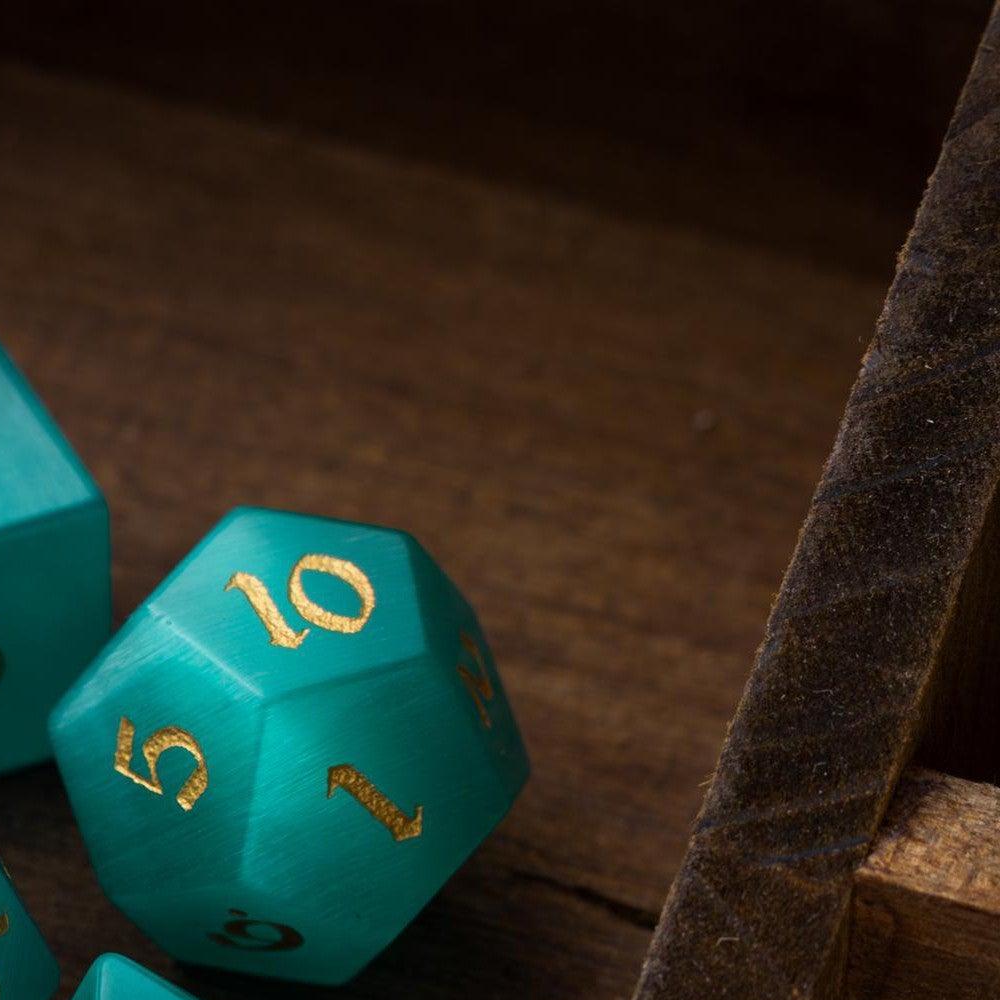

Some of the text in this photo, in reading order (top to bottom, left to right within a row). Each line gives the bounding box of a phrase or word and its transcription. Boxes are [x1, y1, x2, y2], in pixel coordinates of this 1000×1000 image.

[225, 553, 376, 650] 10
[114, 716, 209, 813] 5
[328, 764, 423, 842] 1
